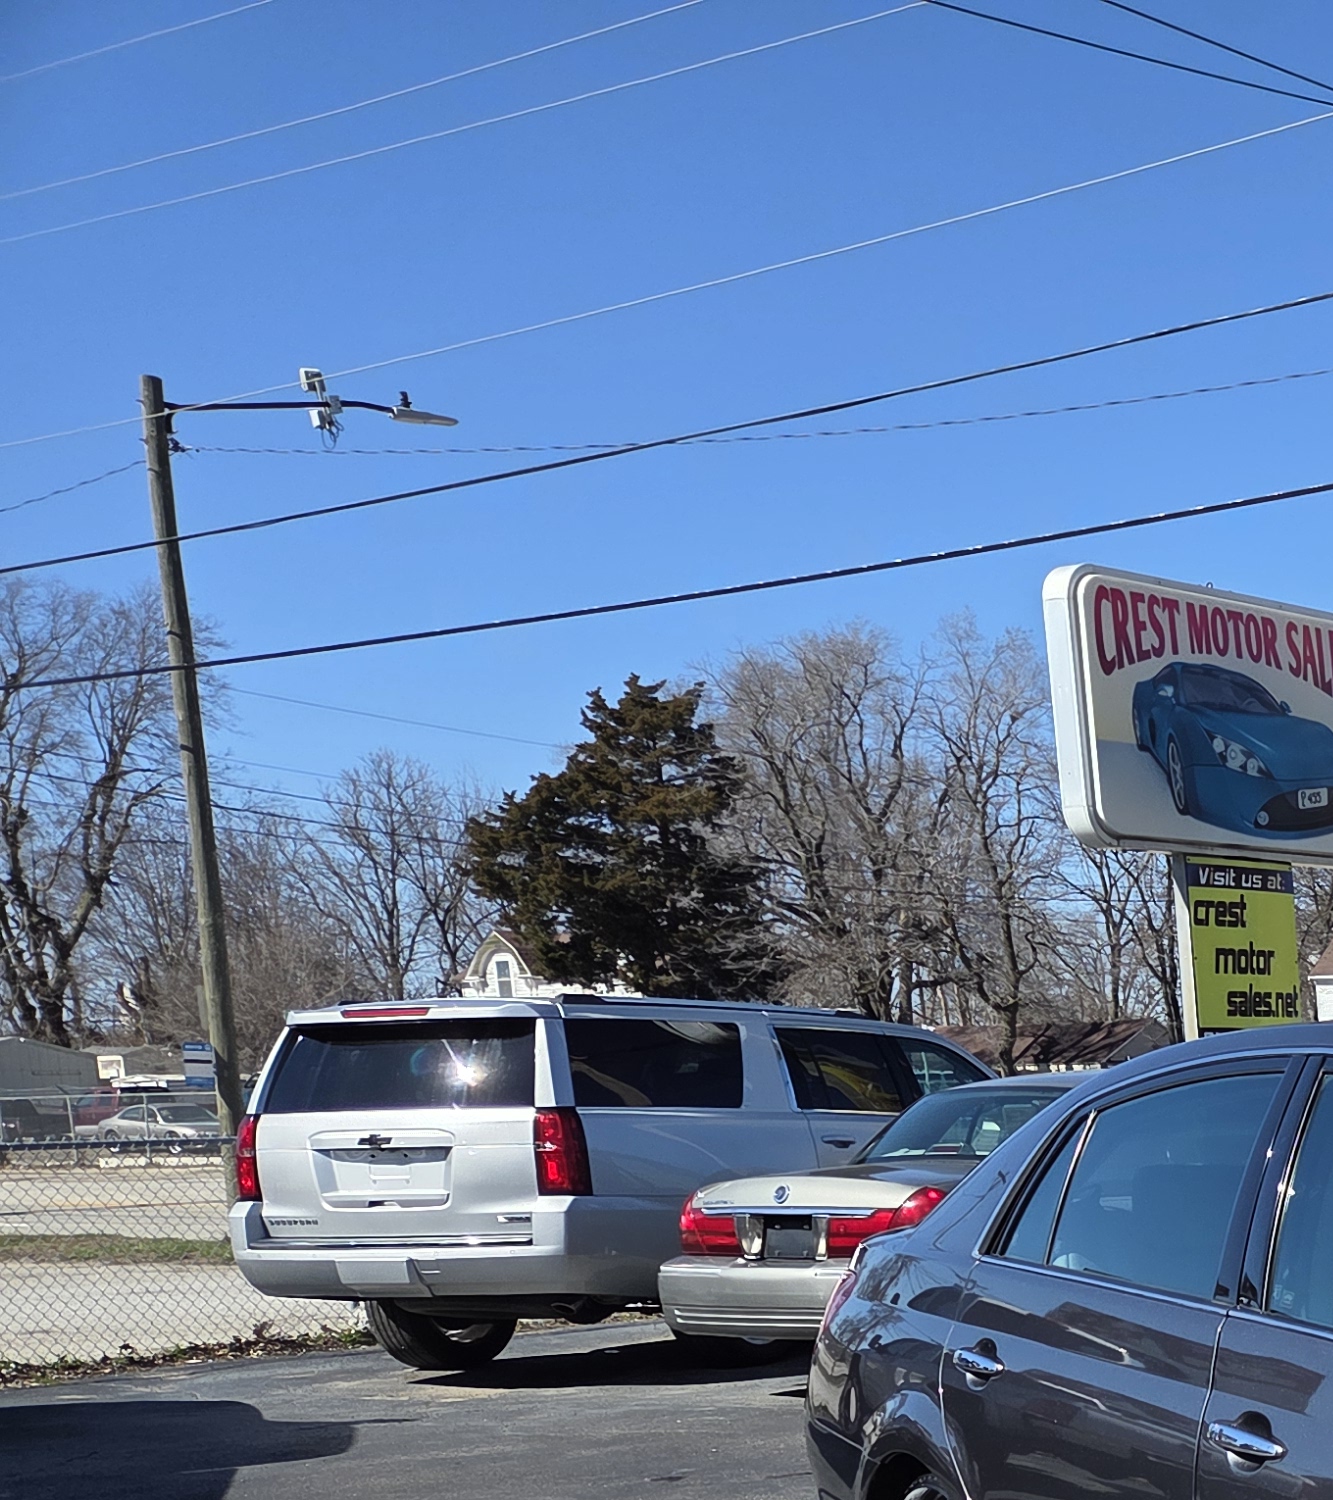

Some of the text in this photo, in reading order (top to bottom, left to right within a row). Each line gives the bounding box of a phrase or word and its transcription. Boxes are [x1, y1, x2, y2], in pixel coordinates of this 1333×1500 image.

[1094, 584, 1181, 676] CREST
[1186, 601, 1282, 671] MOTOR
[1199, 866, 1236, 887] Visit
[1241, 873, 1262, 888] us
[1193, 893, 1247, 928] crest
[1215, 940, 1275, 976] motor
[1227, 983, 1299, 1018] sales.net
